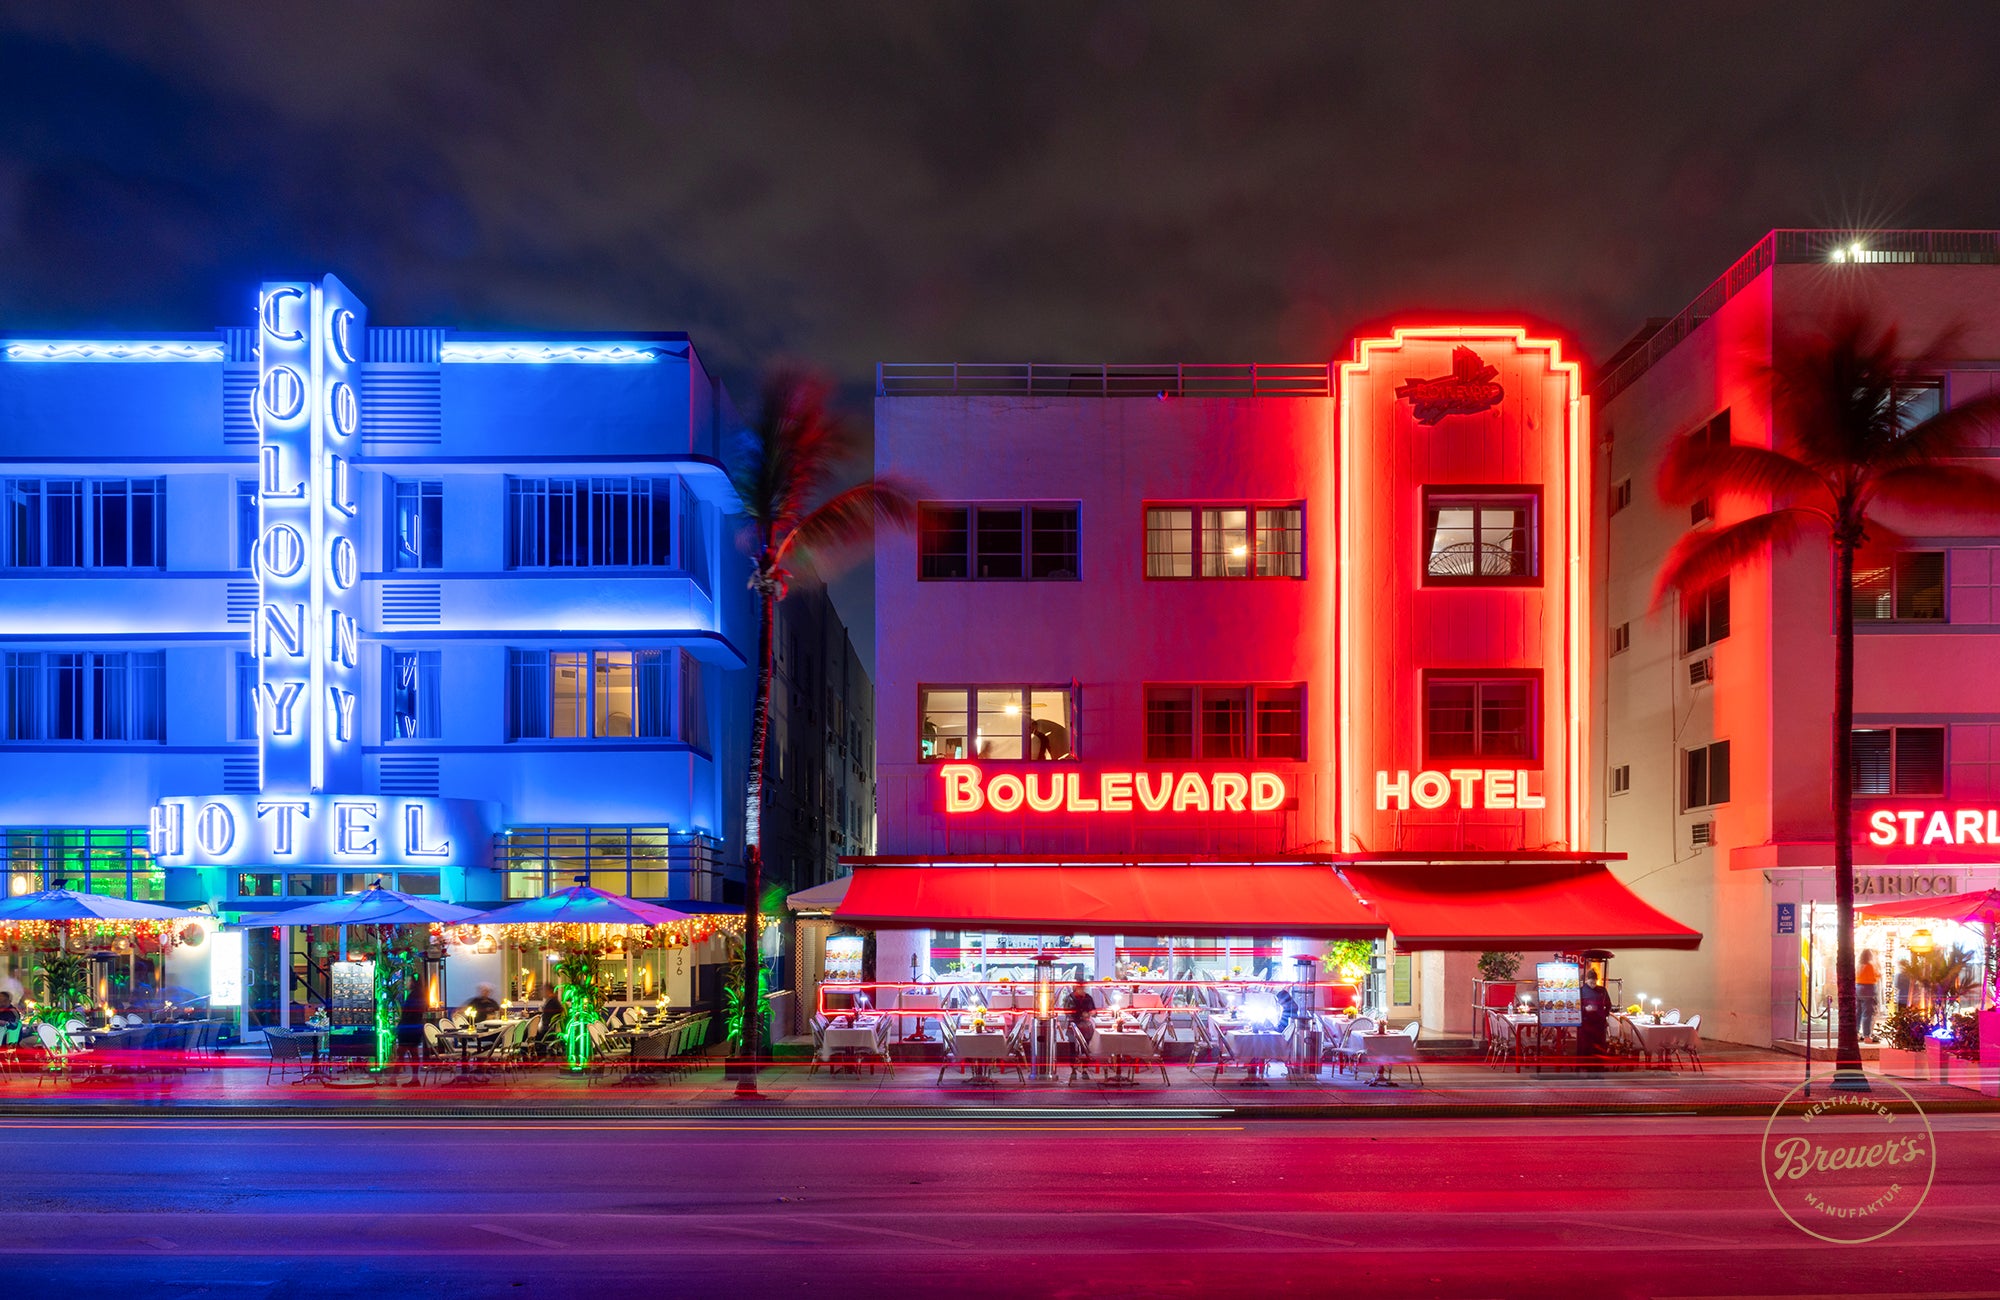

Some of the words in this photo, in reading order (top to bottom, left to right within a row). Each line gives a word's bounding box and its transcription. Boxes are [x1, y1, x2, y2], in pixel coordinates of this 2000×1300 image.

[261, 286, 305, 736] COLONY
[331, 308, 358, 742] COLONY
[940, 764, 1286, 812] BOULEVARD
[1376, 769, 1546, 810] HOTEL
[149, 801, 450, 857] HOTEL
